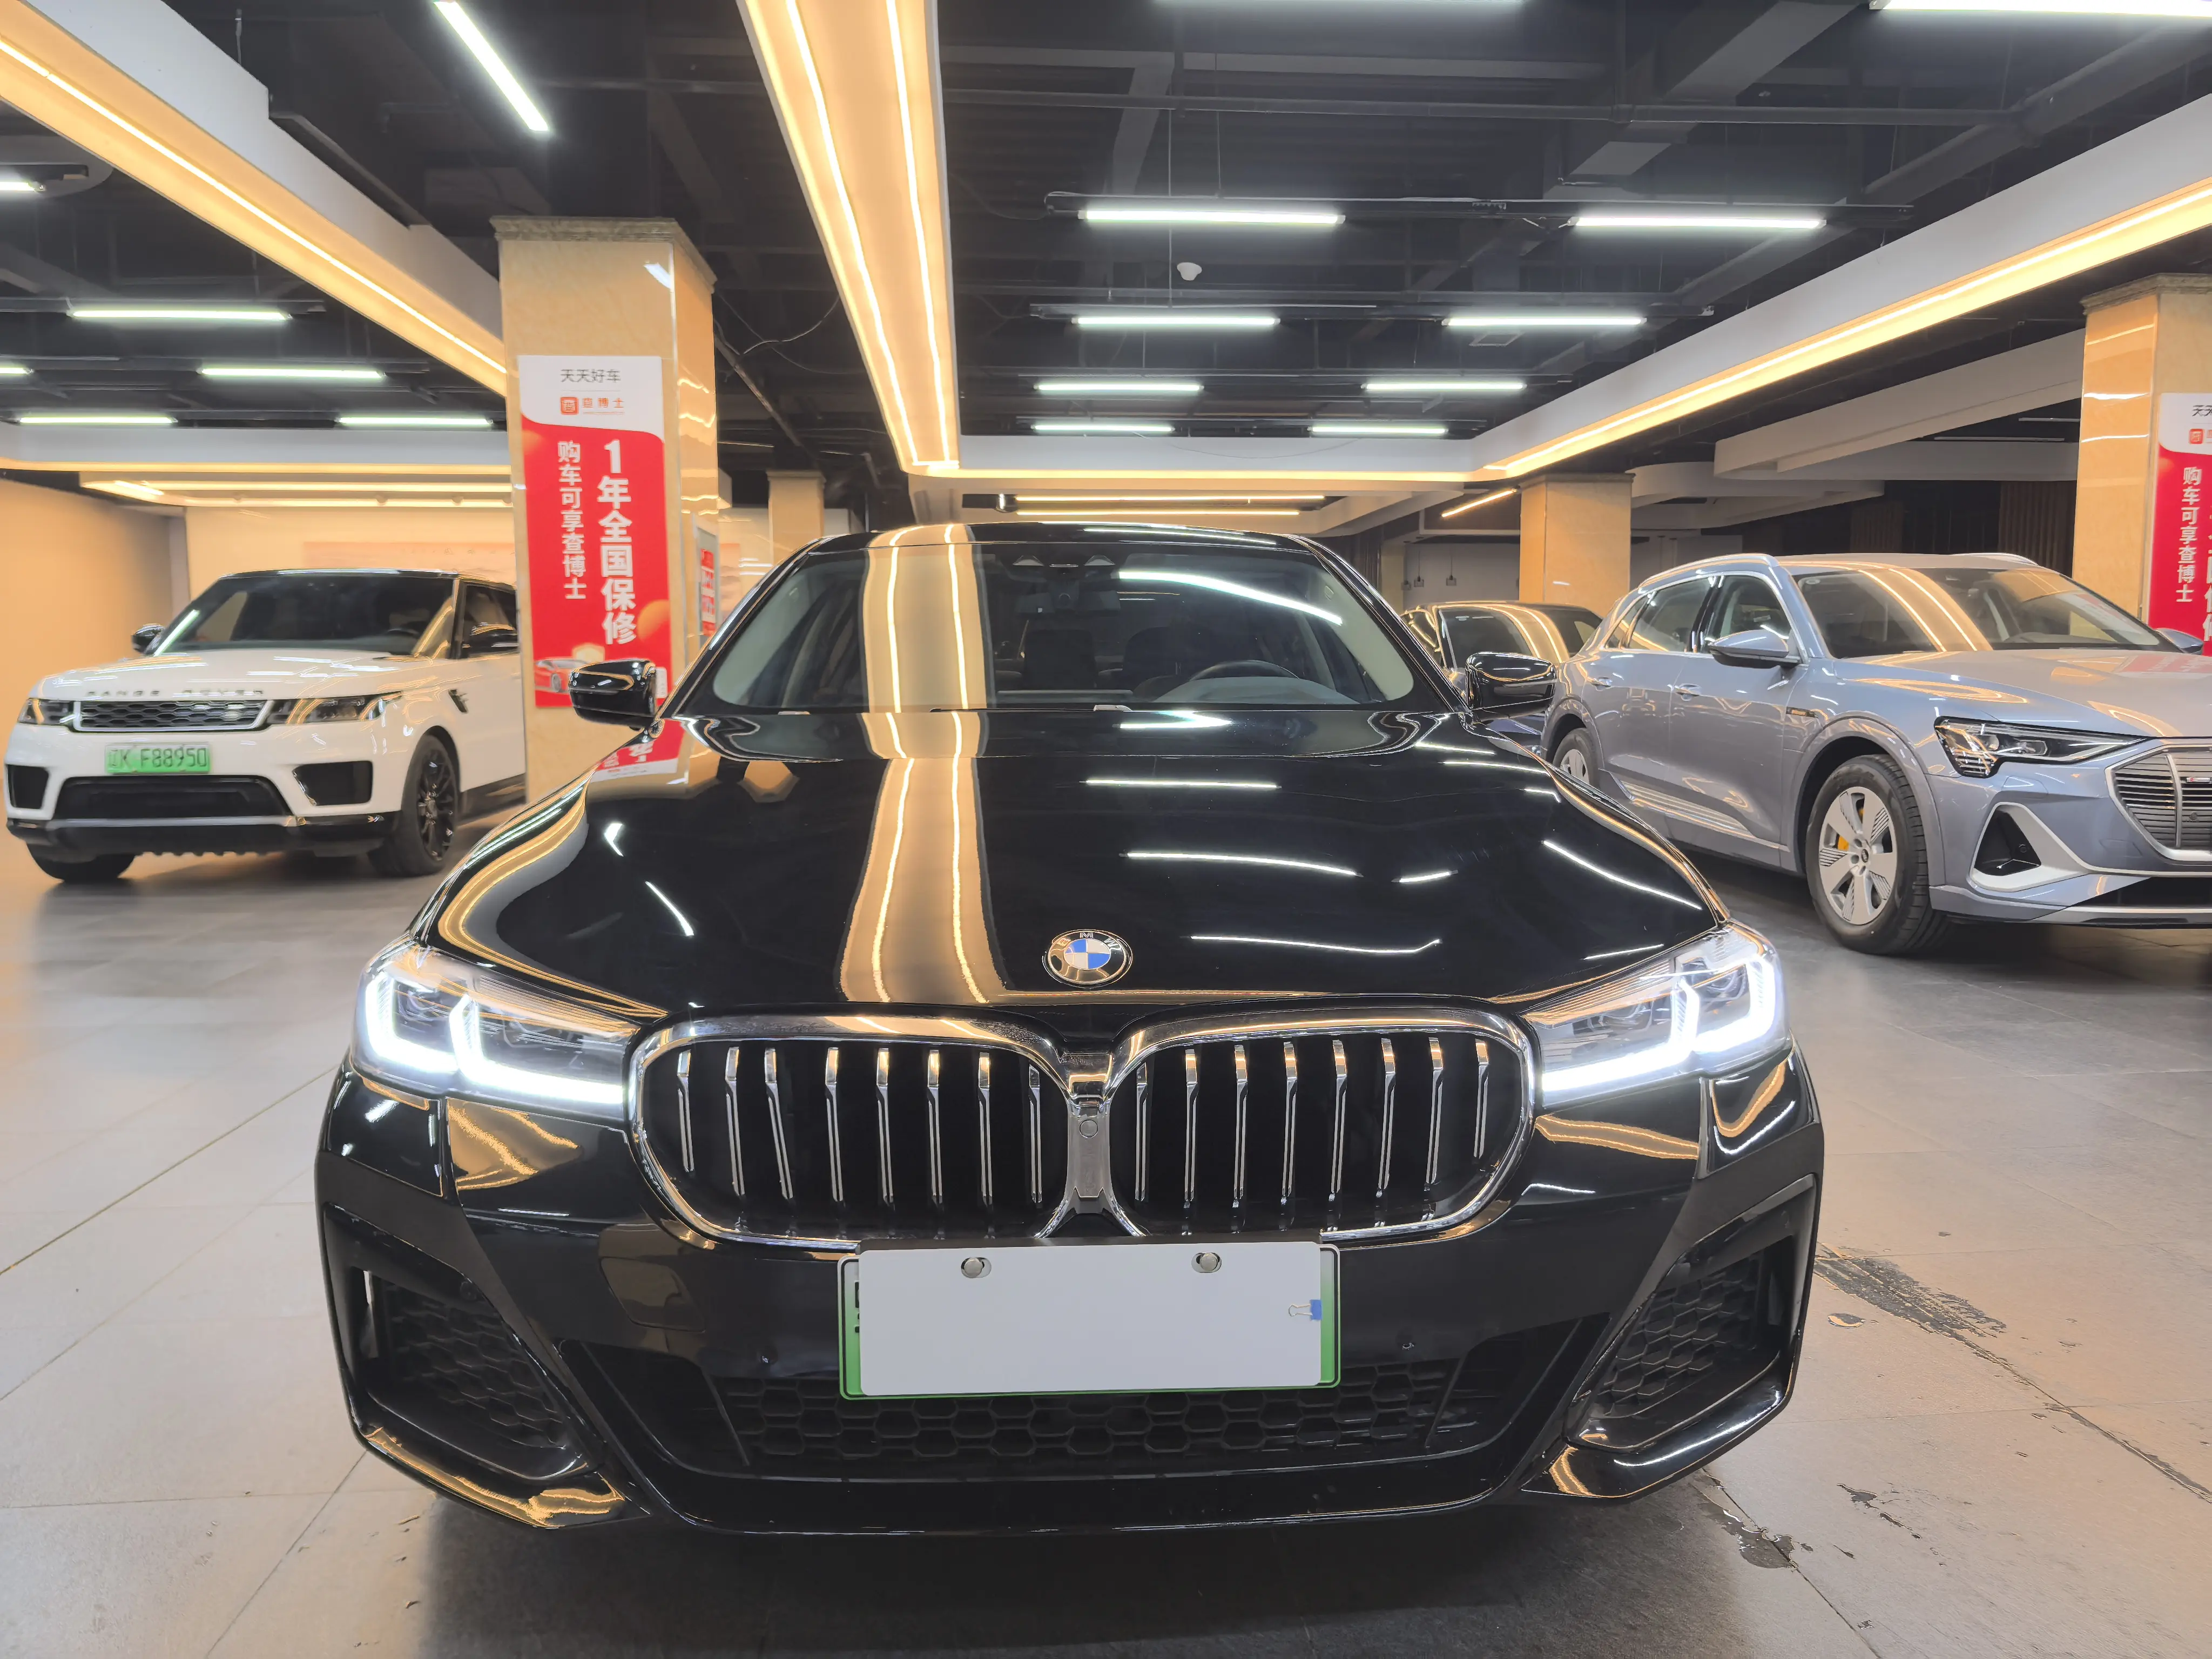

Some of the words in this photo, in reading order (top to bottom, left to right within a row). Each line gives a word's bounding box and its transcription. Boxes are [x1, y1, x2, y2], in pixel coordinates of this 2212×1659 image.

[561, 369, 621, 383] 天天好车
[557, 441, 587, 599] 购车可享查博士
[597, 439, 637, 645] 1年全国保修
[2175, 467, 2202, 602] 购车可享查博士
[1057, 932, 1119, 949] BMW
